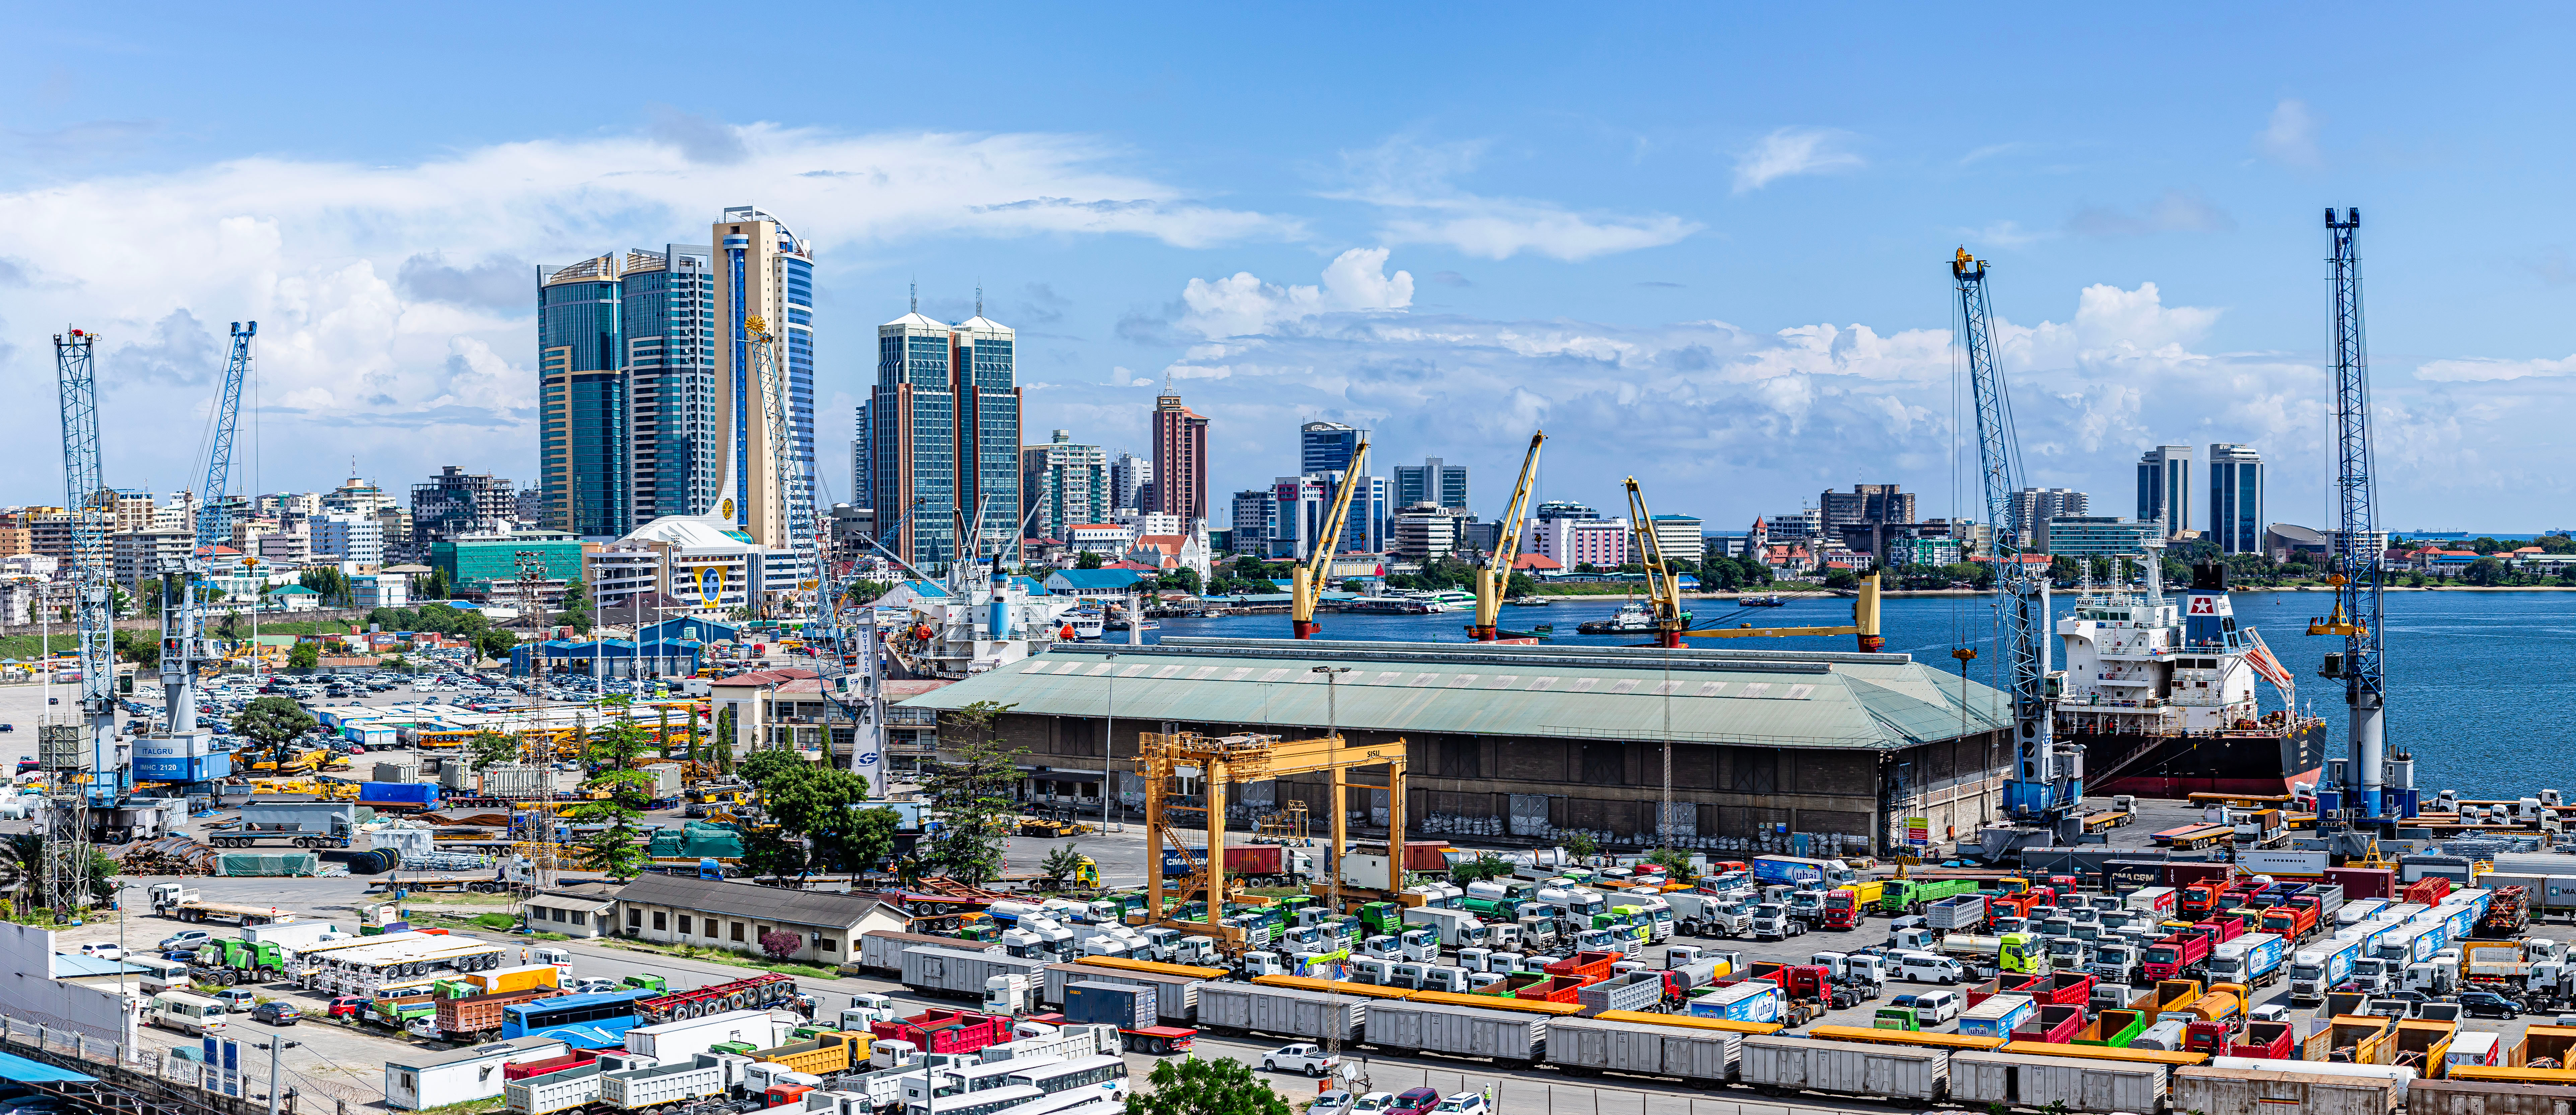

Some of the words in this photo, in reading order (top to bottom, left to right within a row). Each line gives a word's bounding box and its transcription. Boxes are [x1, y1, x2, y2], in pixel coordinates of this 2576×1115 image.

[1796, 870, 1816, 880] uhai
[2447, 923, 2456, 936] uhai
[2369, 941, 2378, 955] uhai
[2416, 942, 2427, 956] uhai
[2251, 954, 2261, 969] uhai
[2331, 961, 2340, 976] uhai
[1758, 998, 1773, 1016] uhai
[2019, 1010, 2030, 1024] uhai
